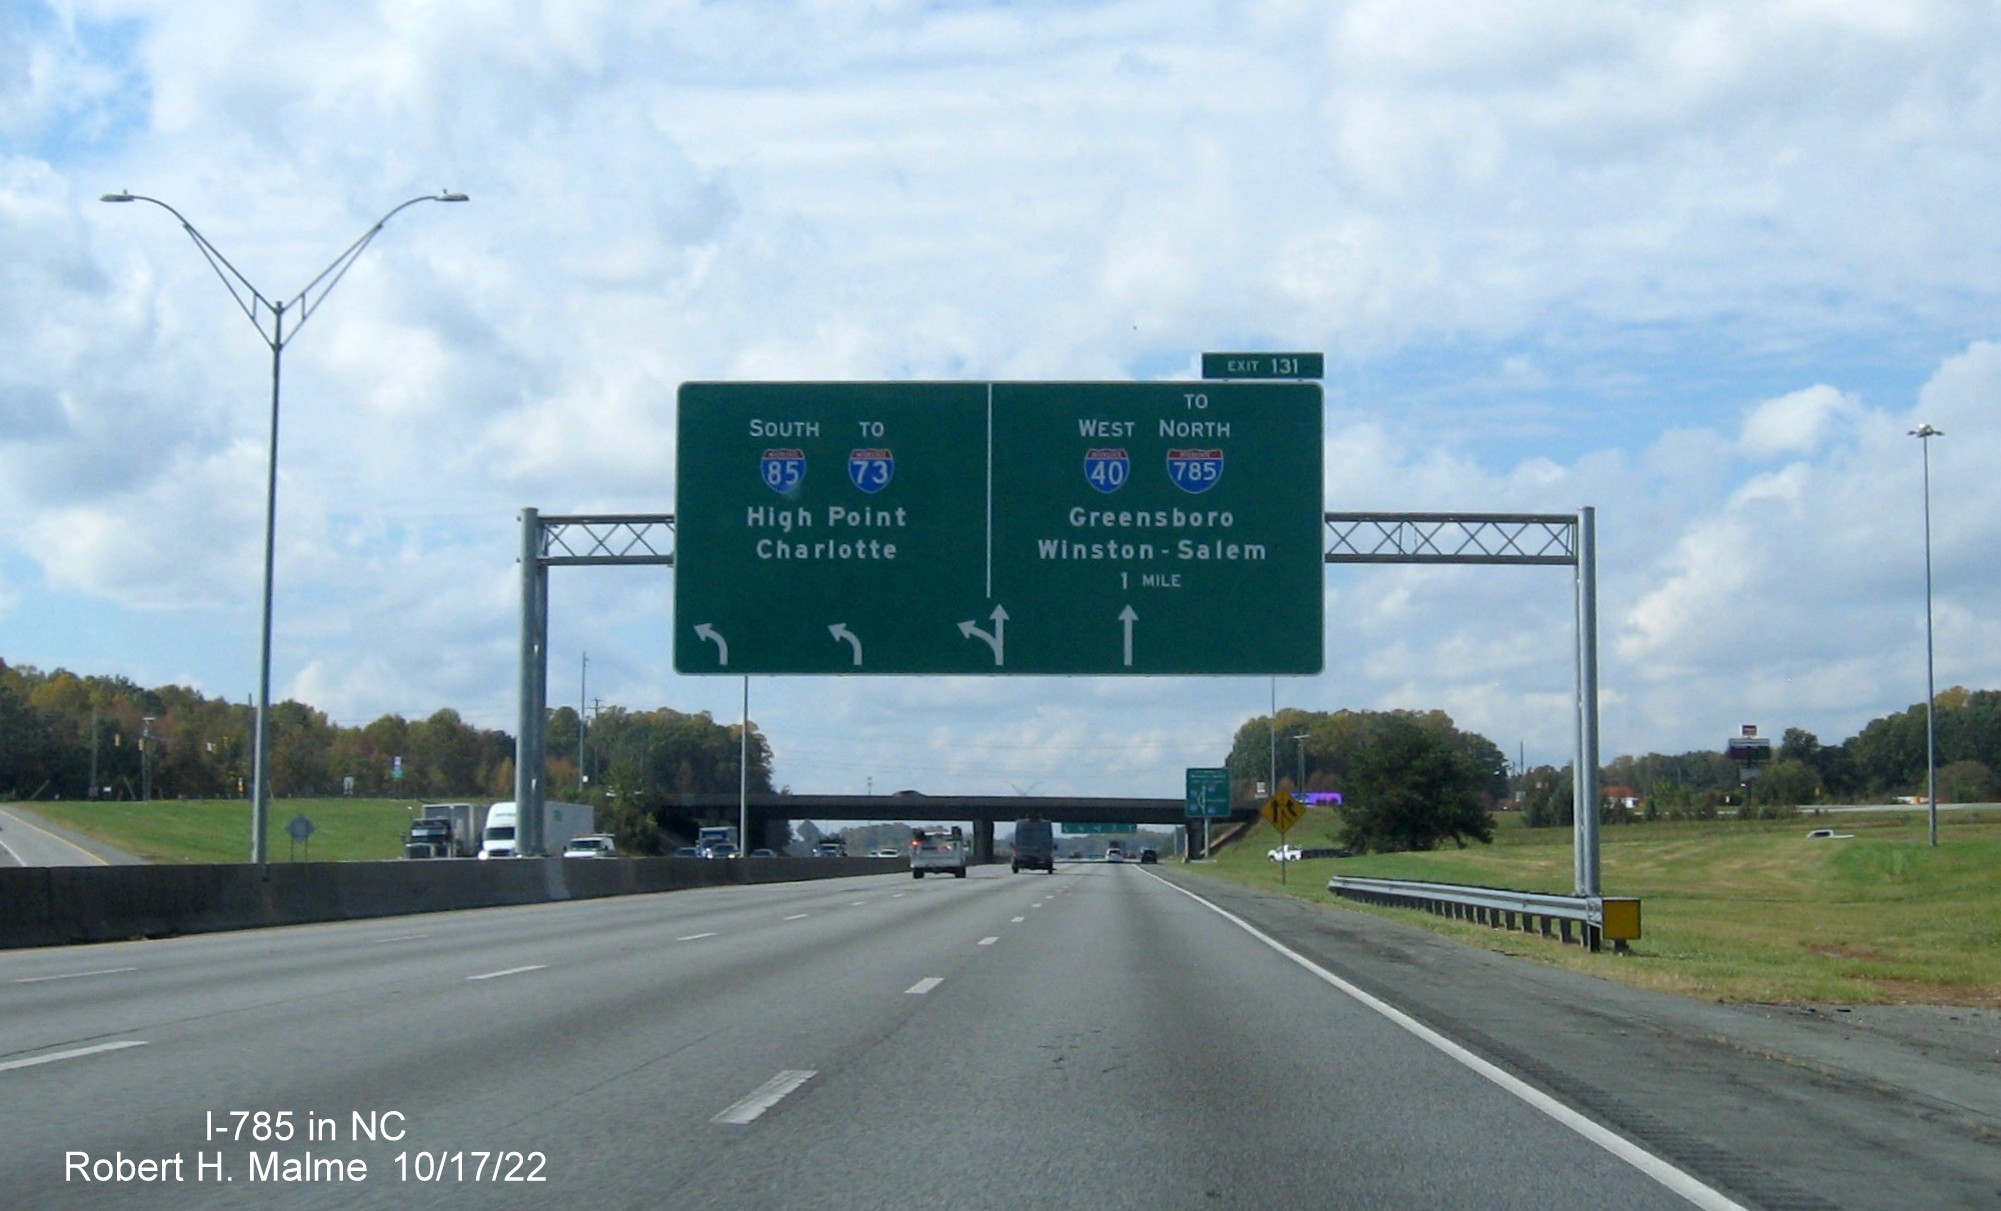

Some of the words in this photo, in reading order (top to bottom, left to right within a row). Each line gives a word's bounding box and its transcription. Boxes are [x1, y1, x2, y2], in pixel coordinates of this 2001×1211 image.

[1227, 360, 1259, 372] EXIT
[1271, 358, 1298, 374] 131
[1183, 393, 1209, 410] TO
[749, 418, 820, 438] SOUTH
[858, 421, 885, 438] TO
[1078, 419, 1135, 437] WEST
[1159, 419, 1231, 438] NORTH
[767, 460, 798, 486] 85
[852, 459, 889, 484] 73
[1090, 460, 1124, 486] 40
[1173, 461, 1217, 481] 785
[747, 506, 812, 533] High
[828, 506, 906, 527] Point
[1069, 506, 1234, 527] Greensboro
[756, 538, 897, 560] Charlotte
[1121, 571, 1129, 590] 1
[1142, 574, 1181, 588] MILE
